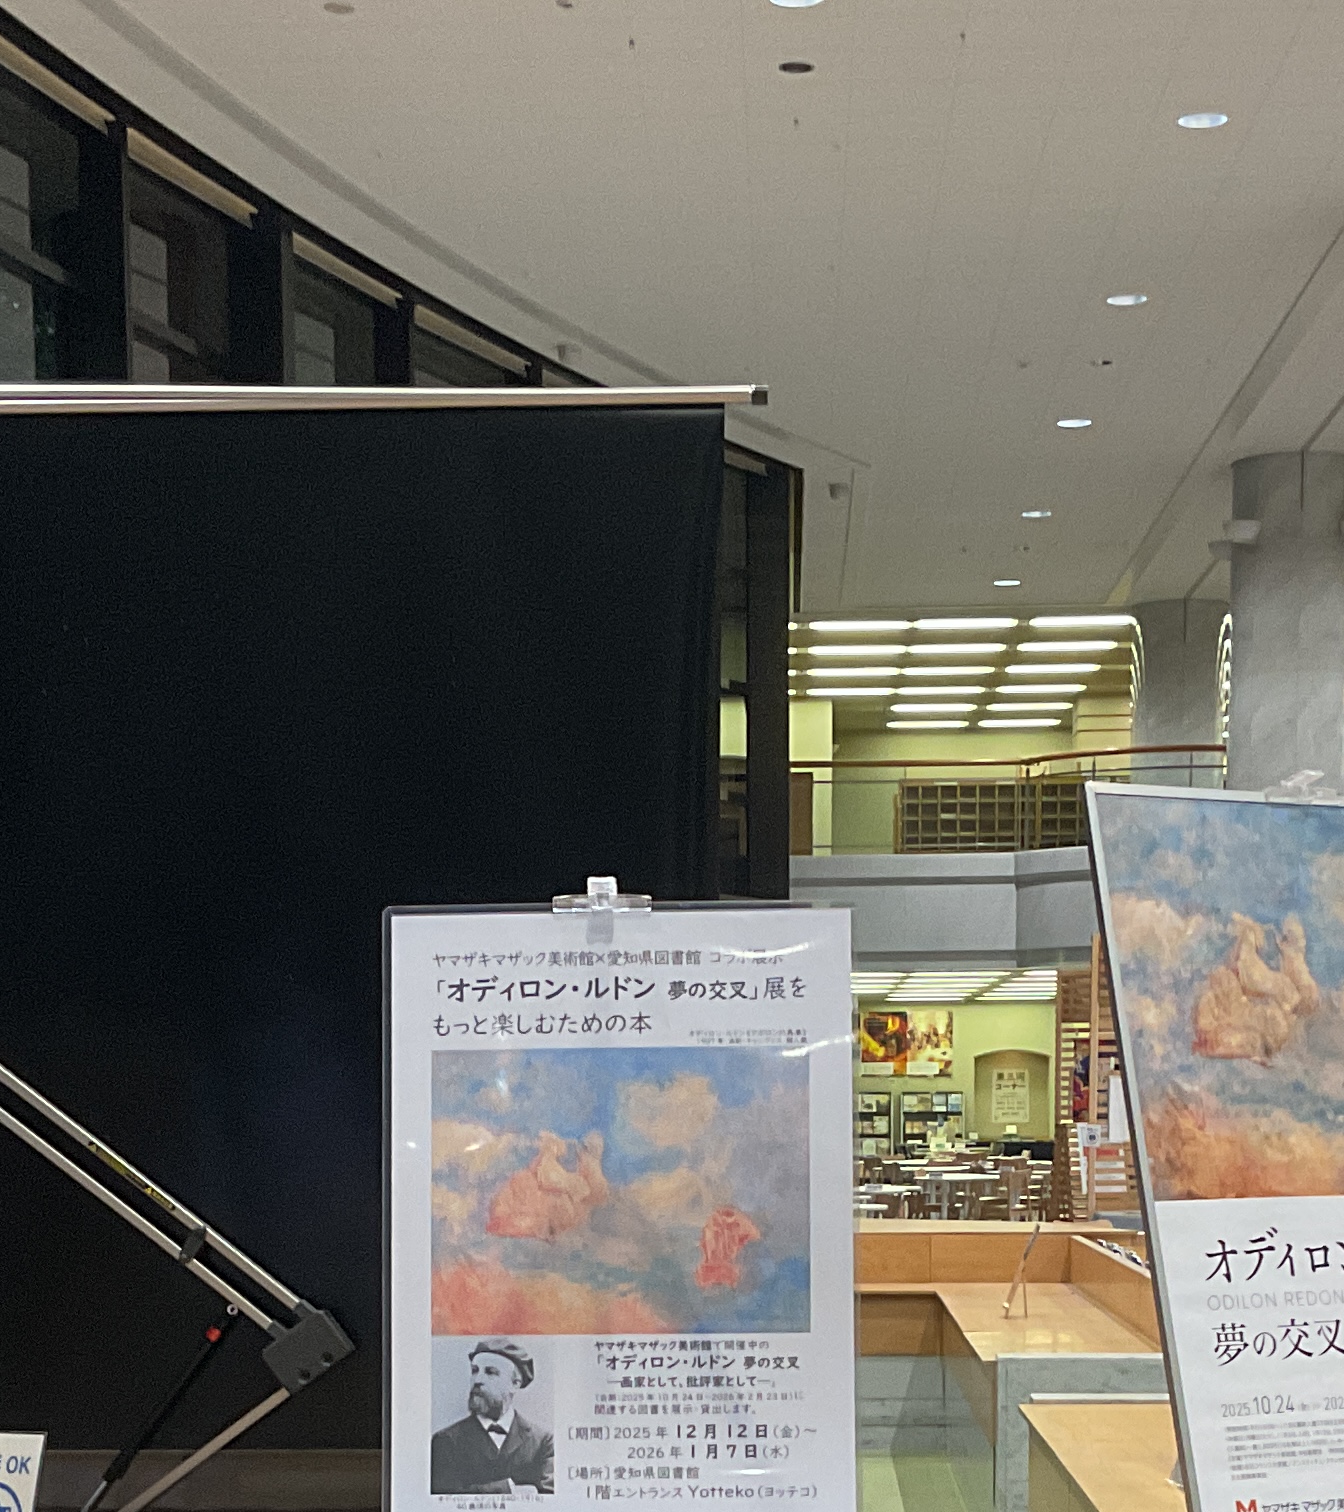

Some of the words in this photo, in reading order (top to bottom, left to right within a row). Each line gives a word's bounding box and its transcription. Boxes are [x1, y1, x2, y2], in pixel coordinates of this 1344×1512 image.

[433, 1011, 652, 1036] もっと楽しむための本
[1207, 1292, 1278, 1312] ODILON
[743, 1356, 800, 1370] 夢の交叉
[6, 1456, 32, 1474] OK
